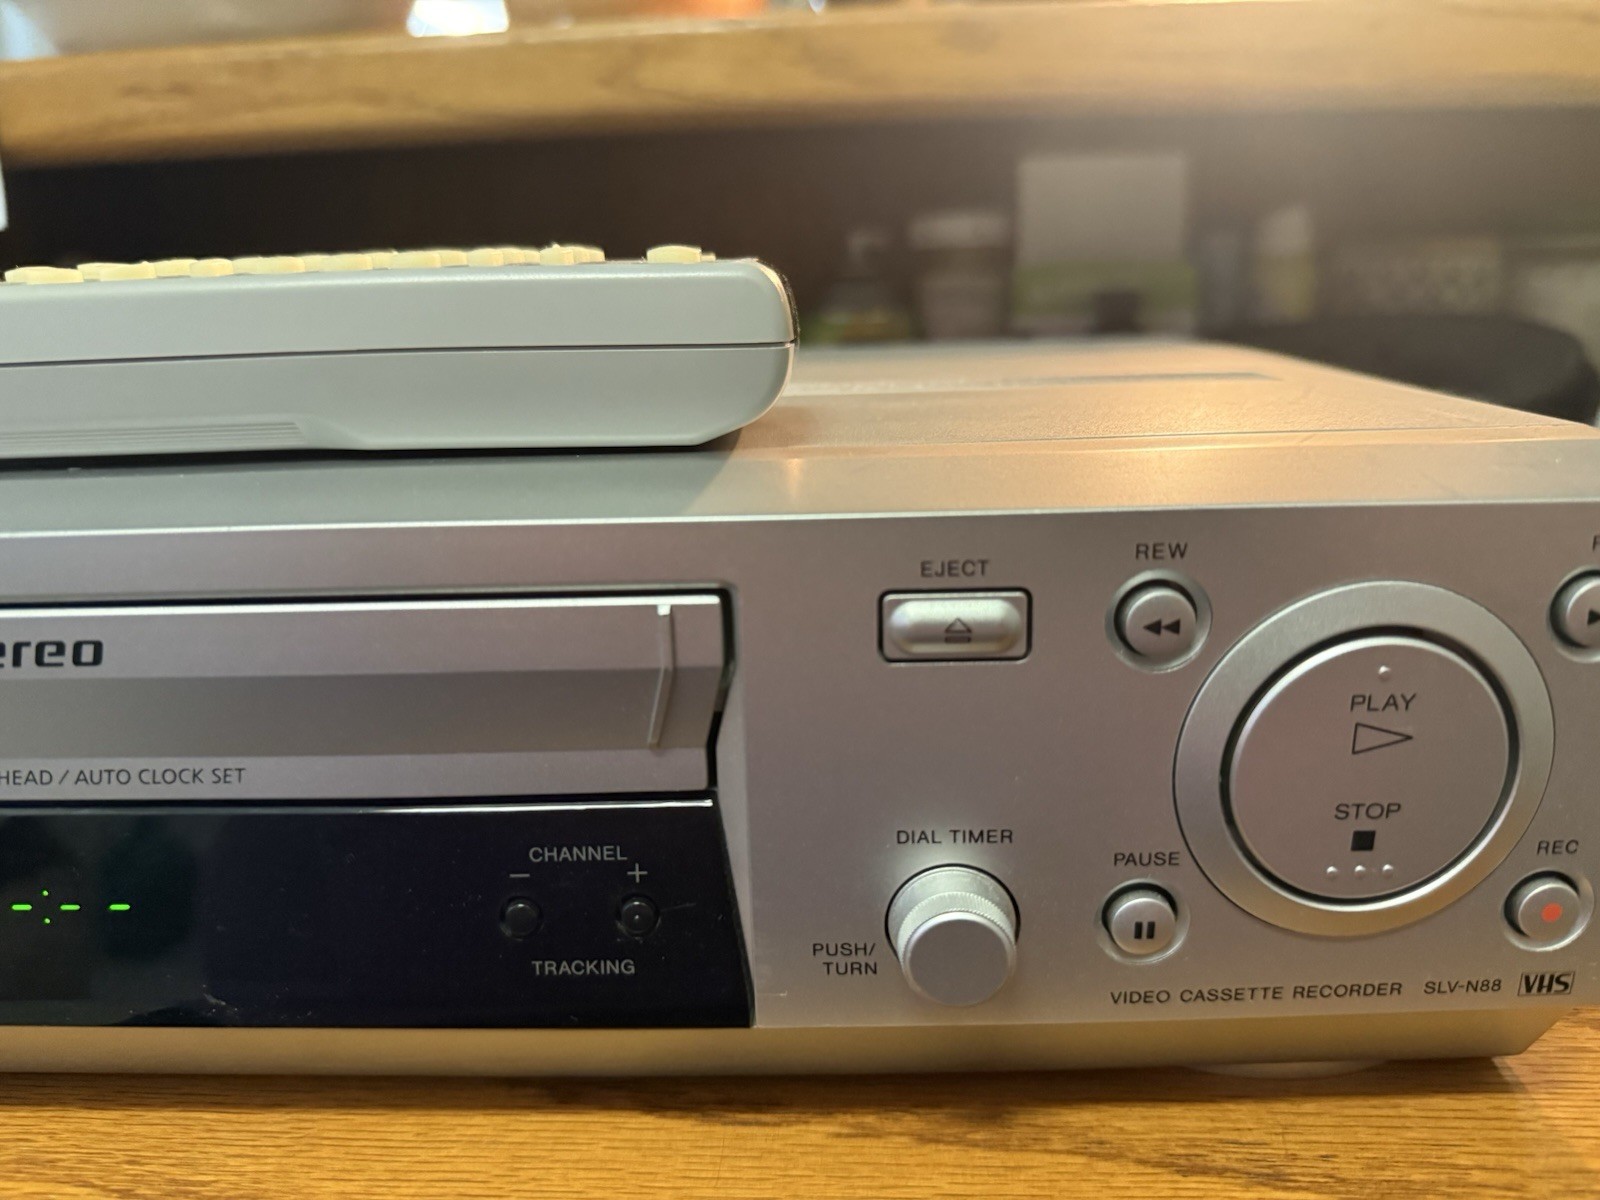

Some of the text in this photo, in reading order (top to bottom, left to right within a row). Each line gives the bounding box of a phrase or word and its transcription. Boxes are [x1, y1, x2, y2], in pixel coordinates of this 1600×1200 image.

[1135, 542, 1188, 560] REW
[920, 559, 989, 578] EJECT
[0, 639, 104, 668] reo
[1349, 693, 1417, 712] PLAY
[74, 768, 131, 786] AUTO
[138, 768, 204, 785] CLOCK
[211, 767, 247, 784] SET
[1334, 802, 1402, 821] STOP
[896, 829, 1013, 845] DIAL TIMER
[528, 845, 628, 863] CHANNEL
[1536, 839, 1580, 855] REC
[1113, 851, 1180, 867] PAUSE
[812, 942, 876, 957] PUSH/
[531, 958, 636, 976] TRACKING
[822, 961, 878, 976] TURN
[1110, 978, 1502, 1005] VIDEO CASSETTE RECORDER SLV-N88
[1523, 973, 1572, 994] VHS
